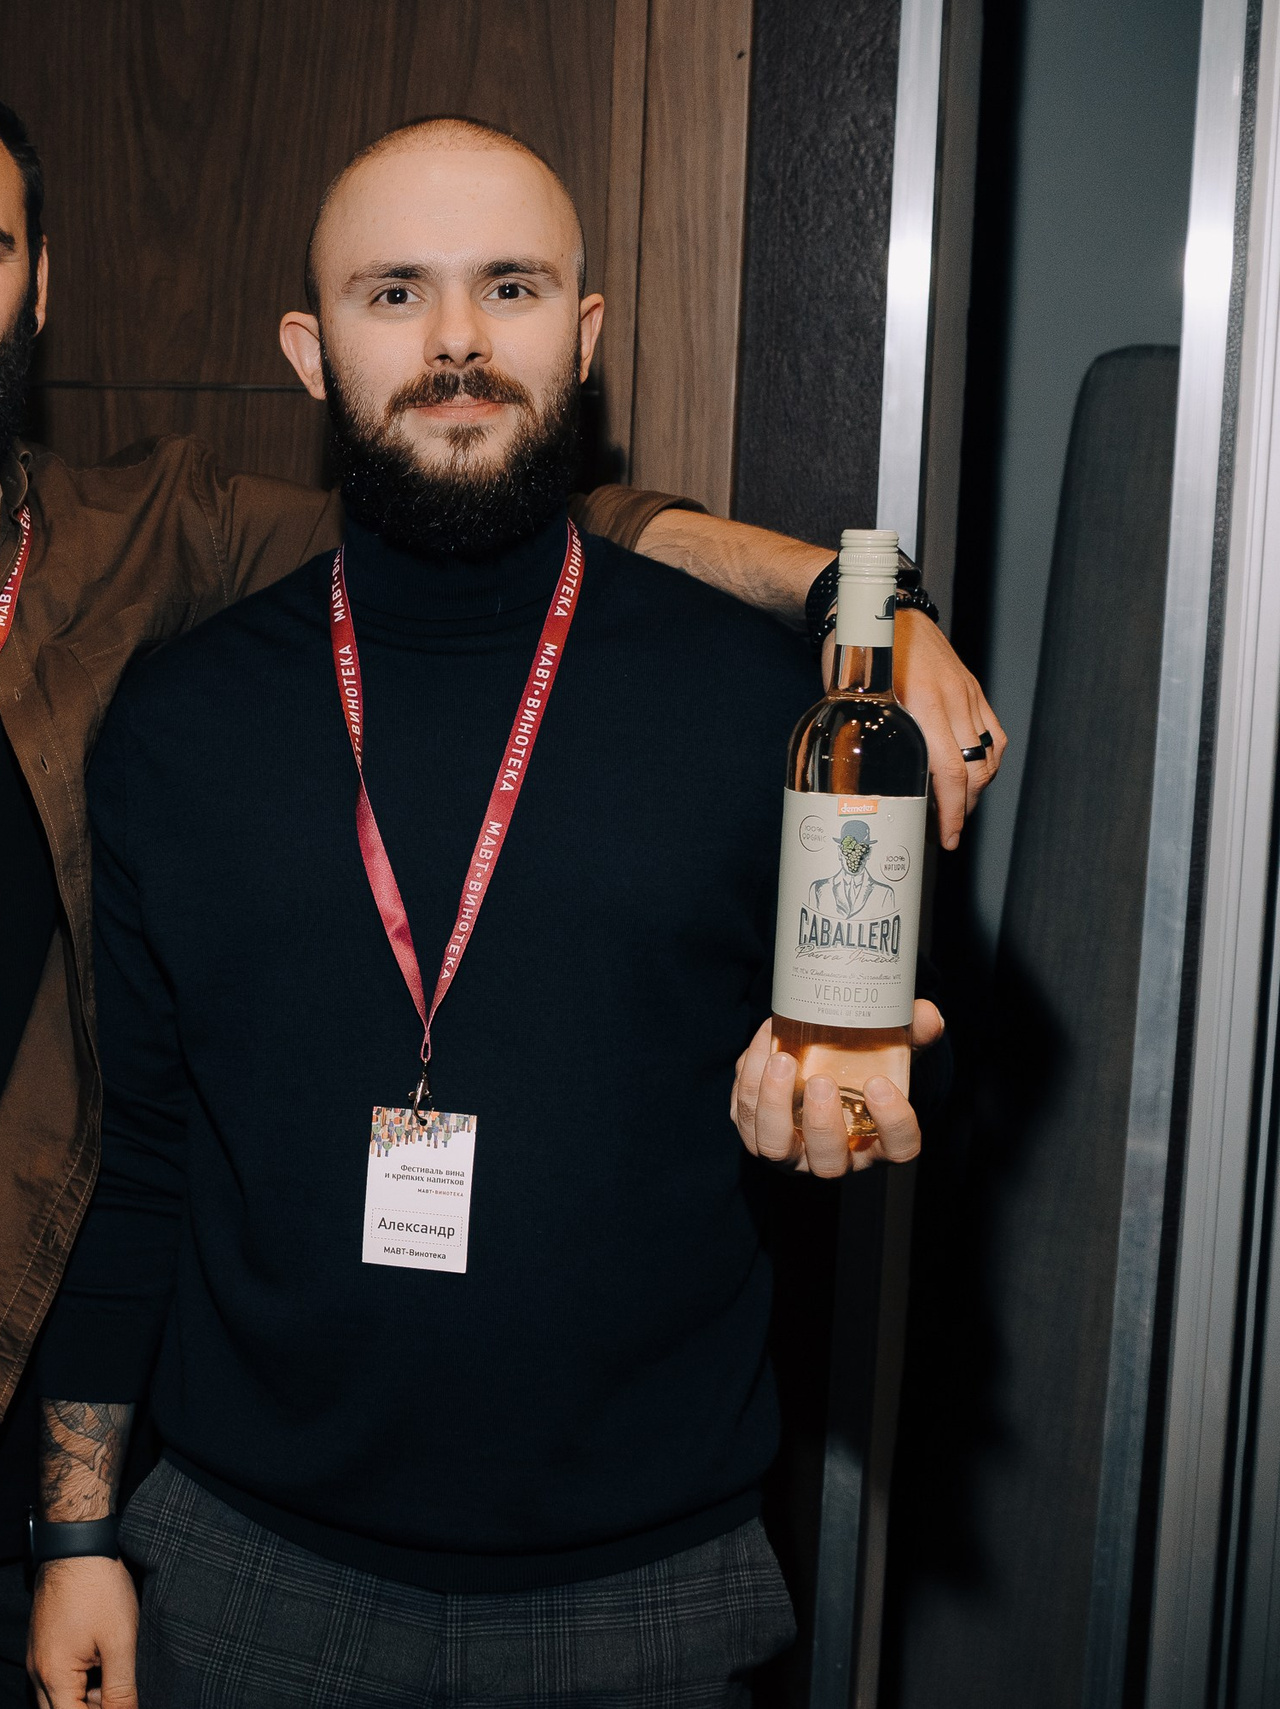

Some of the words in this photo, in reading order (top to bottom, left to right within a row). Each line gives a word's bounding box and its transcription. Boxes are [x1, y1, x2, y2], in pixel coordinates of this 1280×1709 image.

[840, 802, 875, 813] demeter
[798, 906, 901, 956] CABALLERO
[814, 983, 879, 1004] VERDEJO
[400, 1164, 444, 1176] Фестиваль
[445, 1169, 465, 1177] вина
[391, 1174, 425, 1183] крепких
[426, 1176, 465, 1186] напитков
[377, 1217, 455, 1239] Александр
[383, 1246, 447, 1260] МАВТ-Винотека
